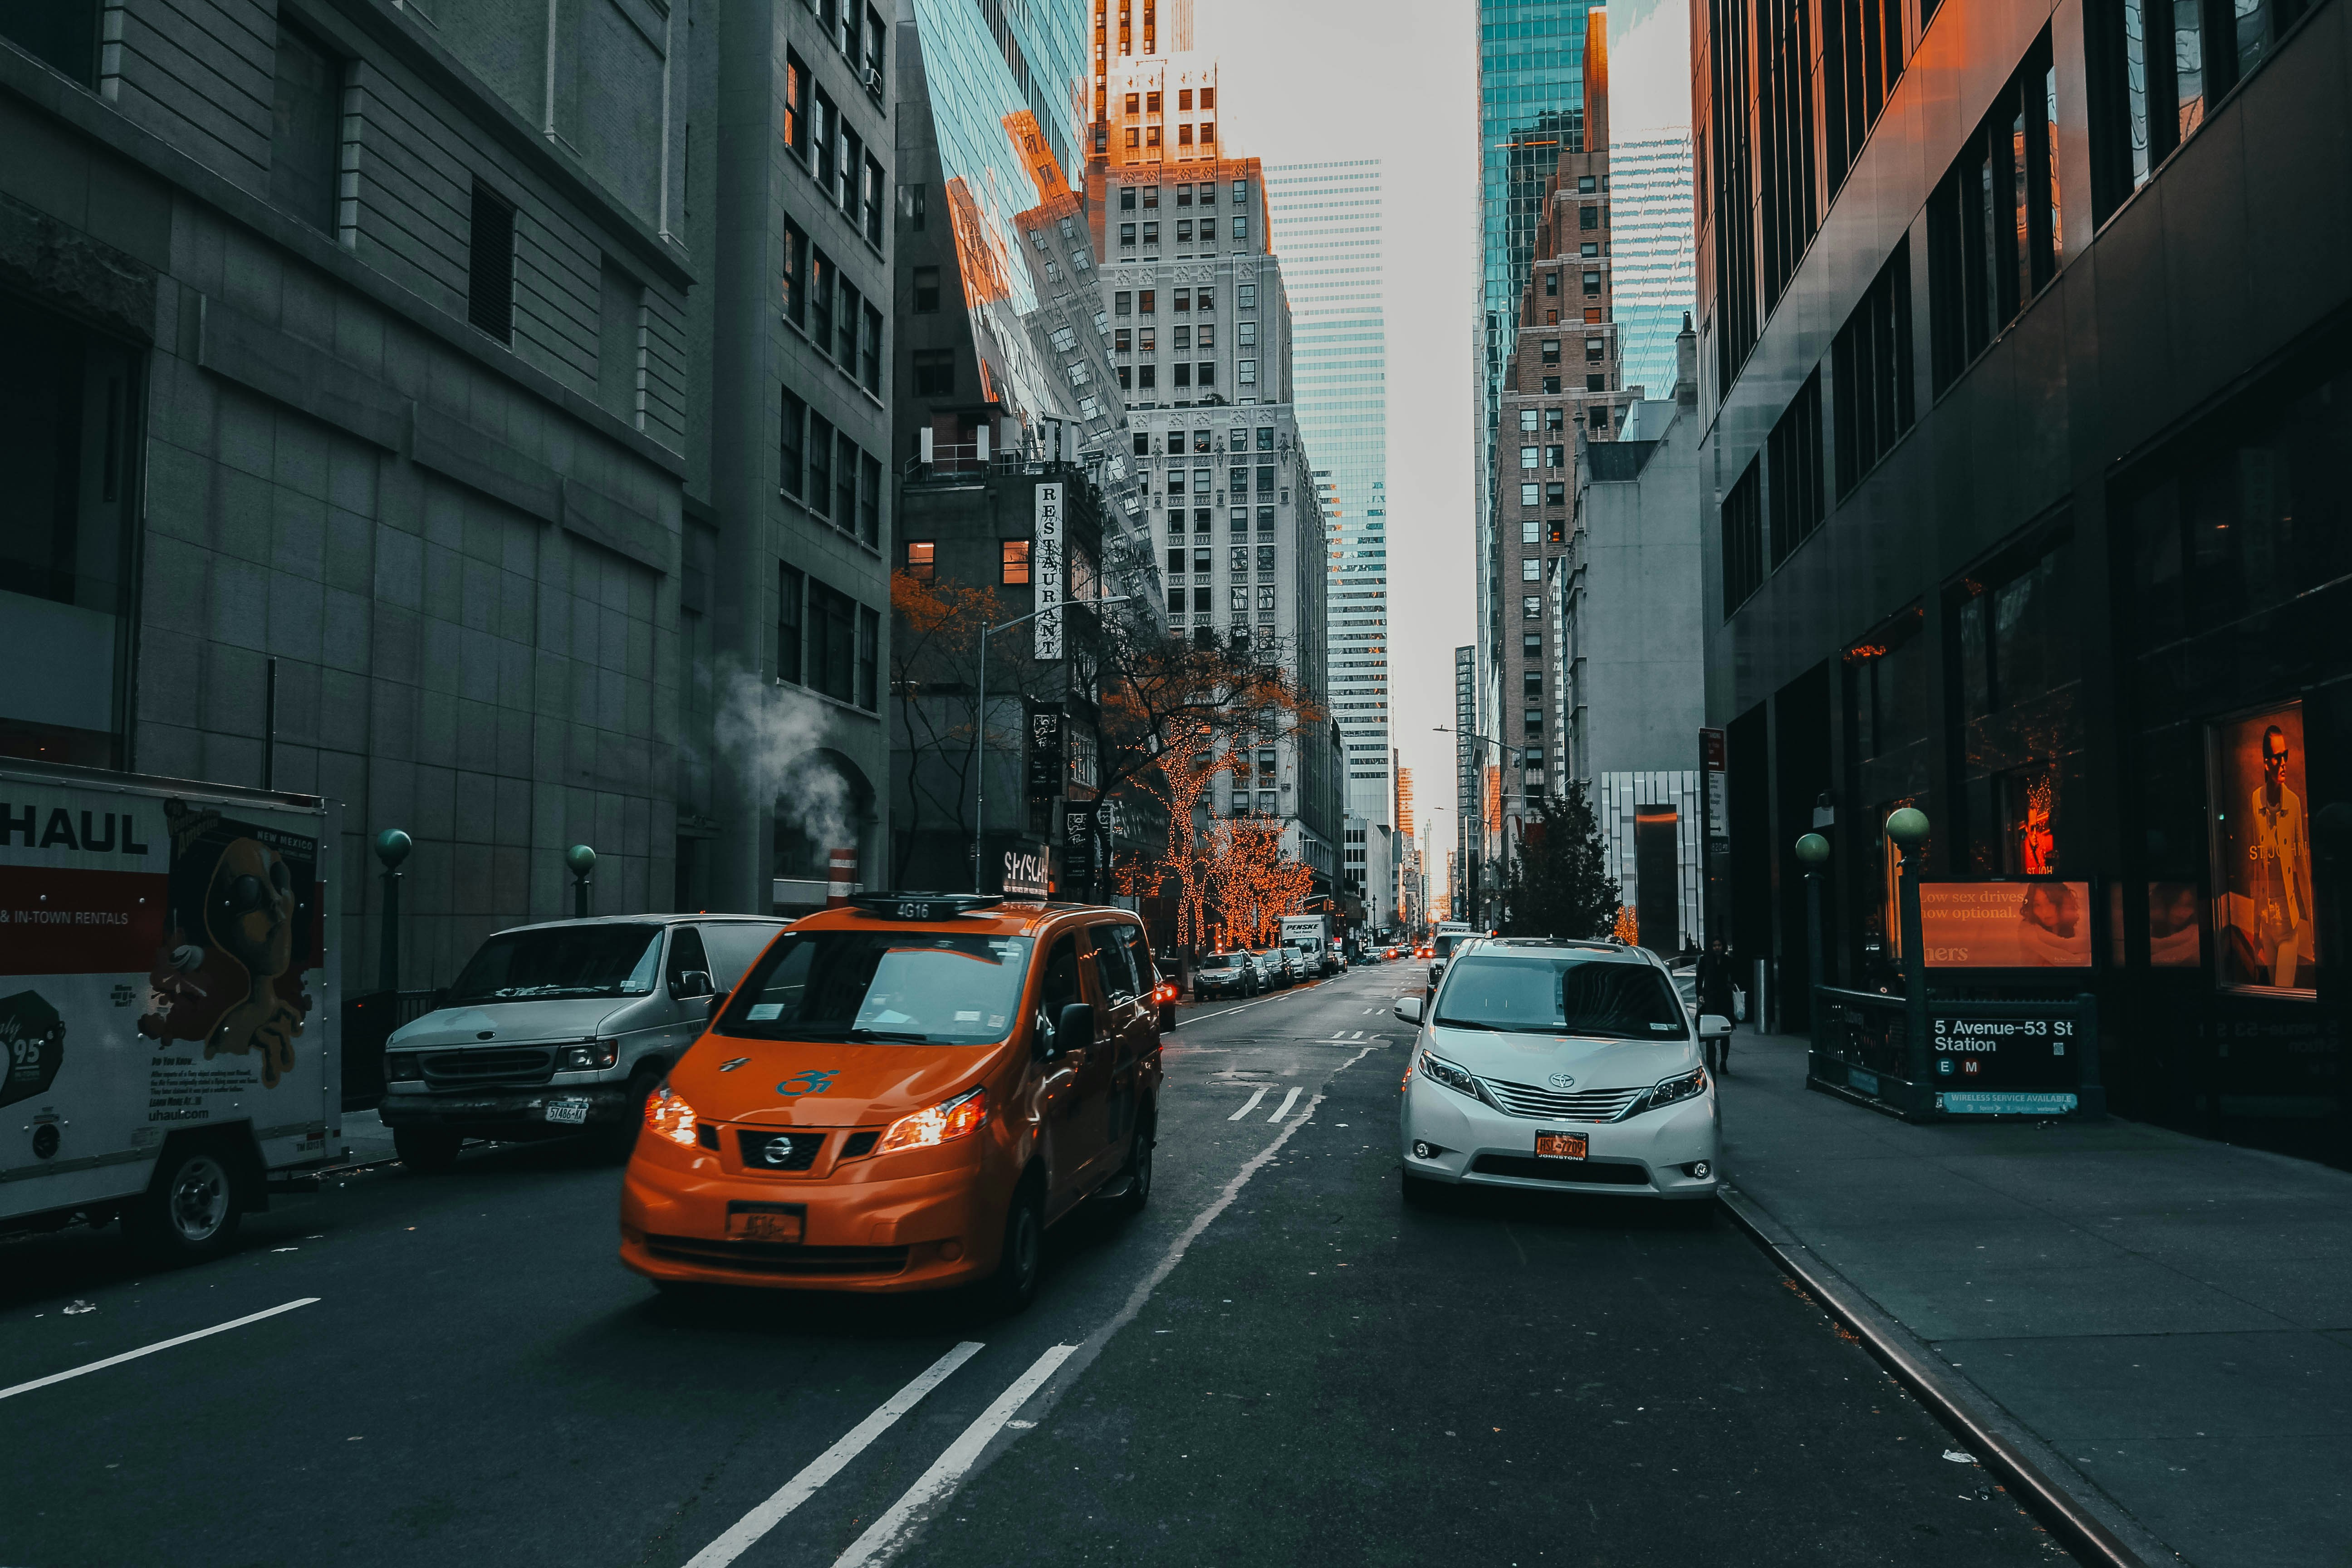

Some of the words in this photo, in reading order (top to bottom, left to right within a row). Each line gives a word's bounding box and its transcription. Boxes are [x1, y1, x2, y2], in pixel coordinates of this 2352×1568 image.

[1043, 489, 1056, 654] RESTAURANT
[0, 802, 148, 855] HAUL
[257, 831, 278, 843] NEW
[280, 836, 313, 850] MEXICO
[1952, 892, 1975, 903] sex
[1980, 891, 2029, 905] drives,
[897, 903, 929, 917] 4G16
[1952, 906, 2017, 921] optional.
[15, 911, 70, 924] IN-TOWN
[75, 912, 128, 925] RENTALS
[1935, 1020, 1945, 1034] 5
[1953, 1021, 2047, 1035] Avenue-53
[2054, 1022, 2073, 1035] St
[1935, 1037, 1996, 1051] Station
[1940, 1061, 1949, 1072] E
[1966, 1062, 1977, 1072] M
